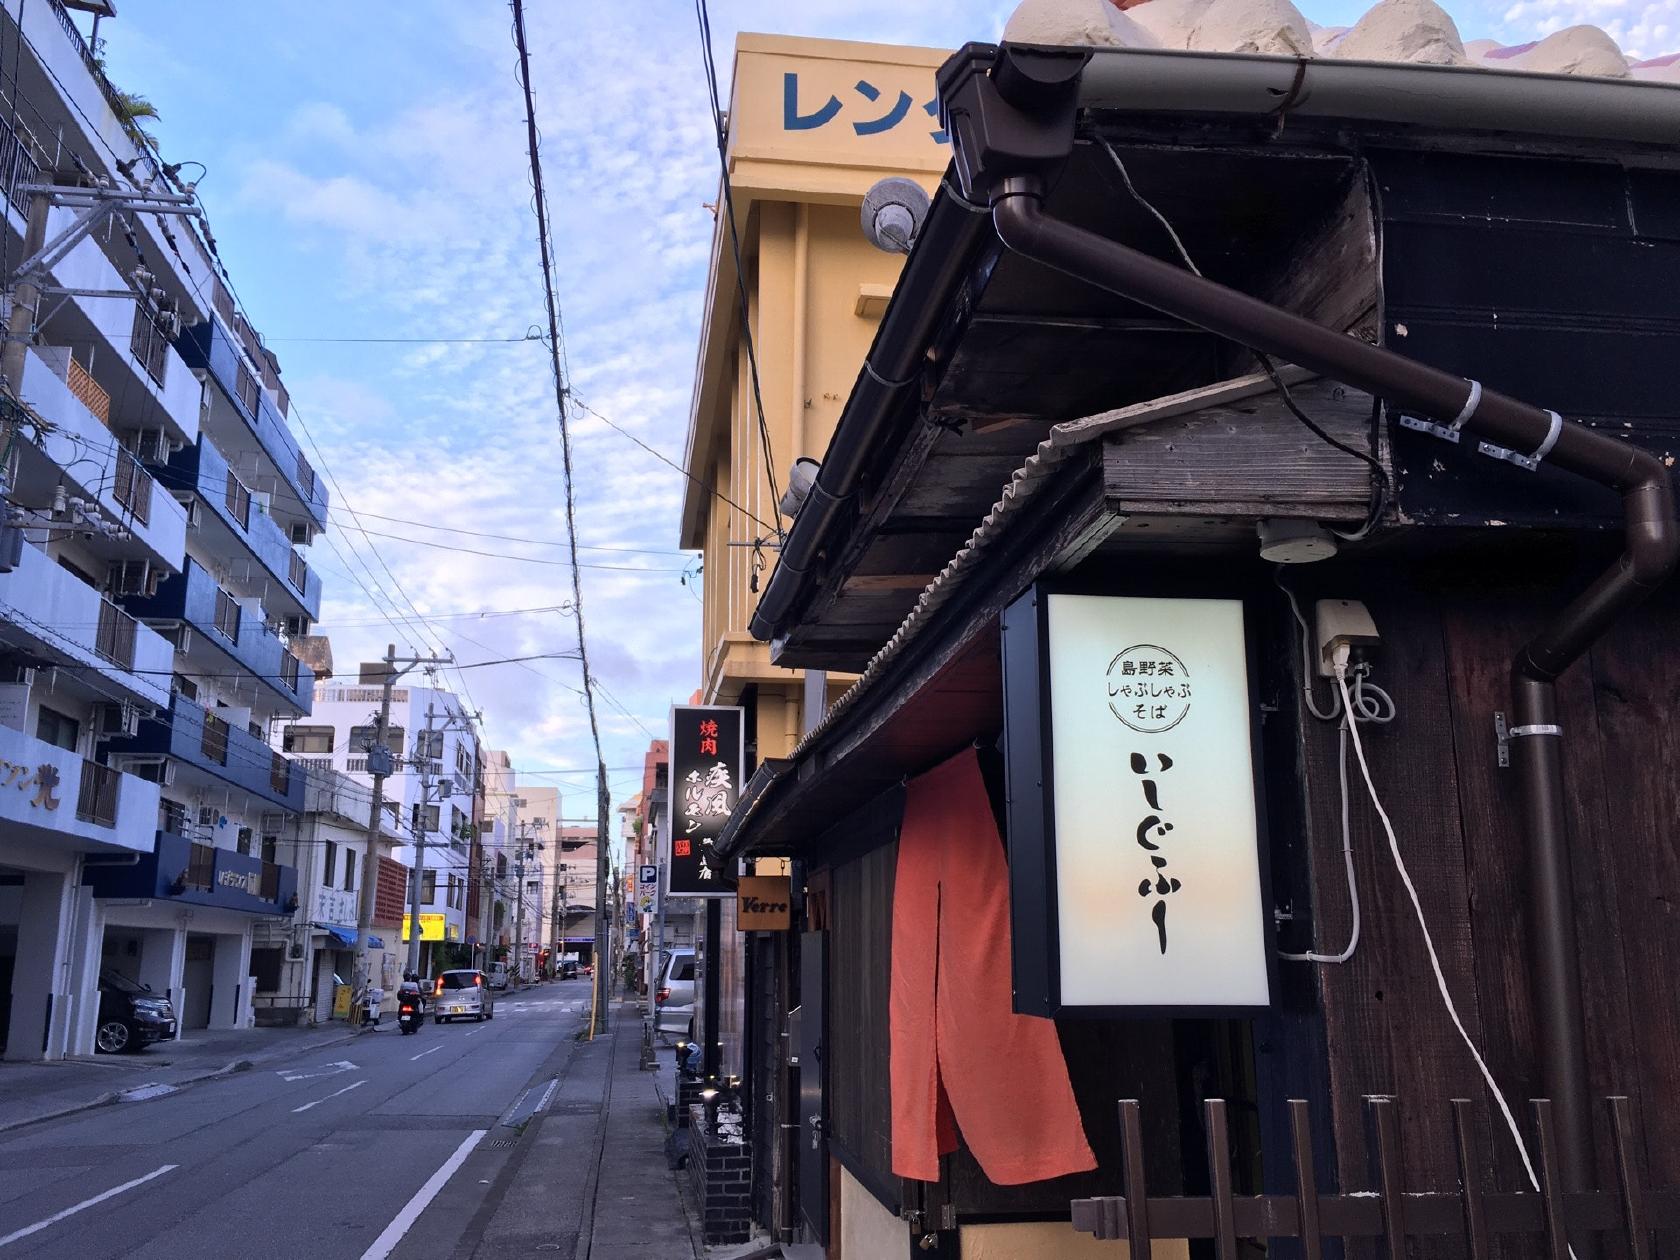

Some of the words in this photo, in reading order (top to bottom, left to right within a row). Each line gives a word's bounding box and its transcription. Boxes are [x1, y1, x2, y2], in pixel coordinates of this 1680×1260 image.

[1120, 660, 1175, 677] 島野菜
[1107, 682, 1192, 698] しゃぶしゃぶ
[1132, 704, 1167, 720] そば
[699, 719, 720, 756] 焼肉
[705, 761, 733, 816] 疾風
[684, 769, 704, 834] ホルモン
[642, 867, 656, 882] P
[740, 896, 788, 914] Verre
